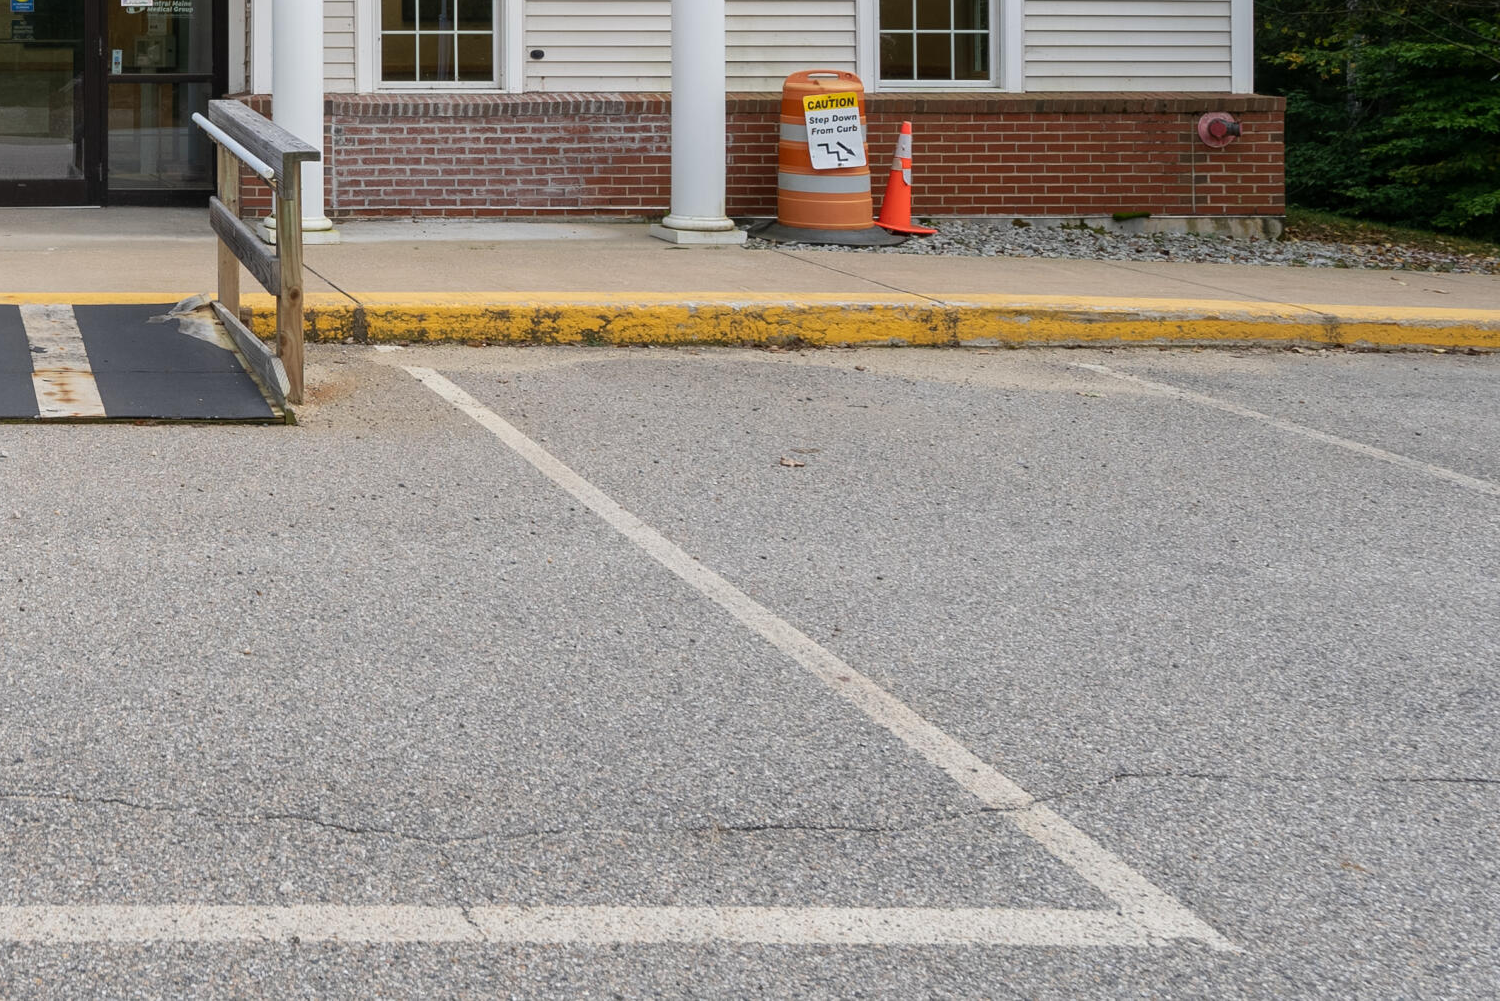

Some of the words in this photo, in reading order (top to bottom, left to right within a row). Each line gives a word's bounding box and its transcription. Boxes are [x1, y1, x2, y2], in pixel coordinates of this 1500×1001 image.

[807, 97, 855, 110] CAUTION
[809, 116, 830, 125] Step
[832, 114, 857, 123] Down
[811, 127, 834, 136] From
[836, 124, 858, 134] Curb
